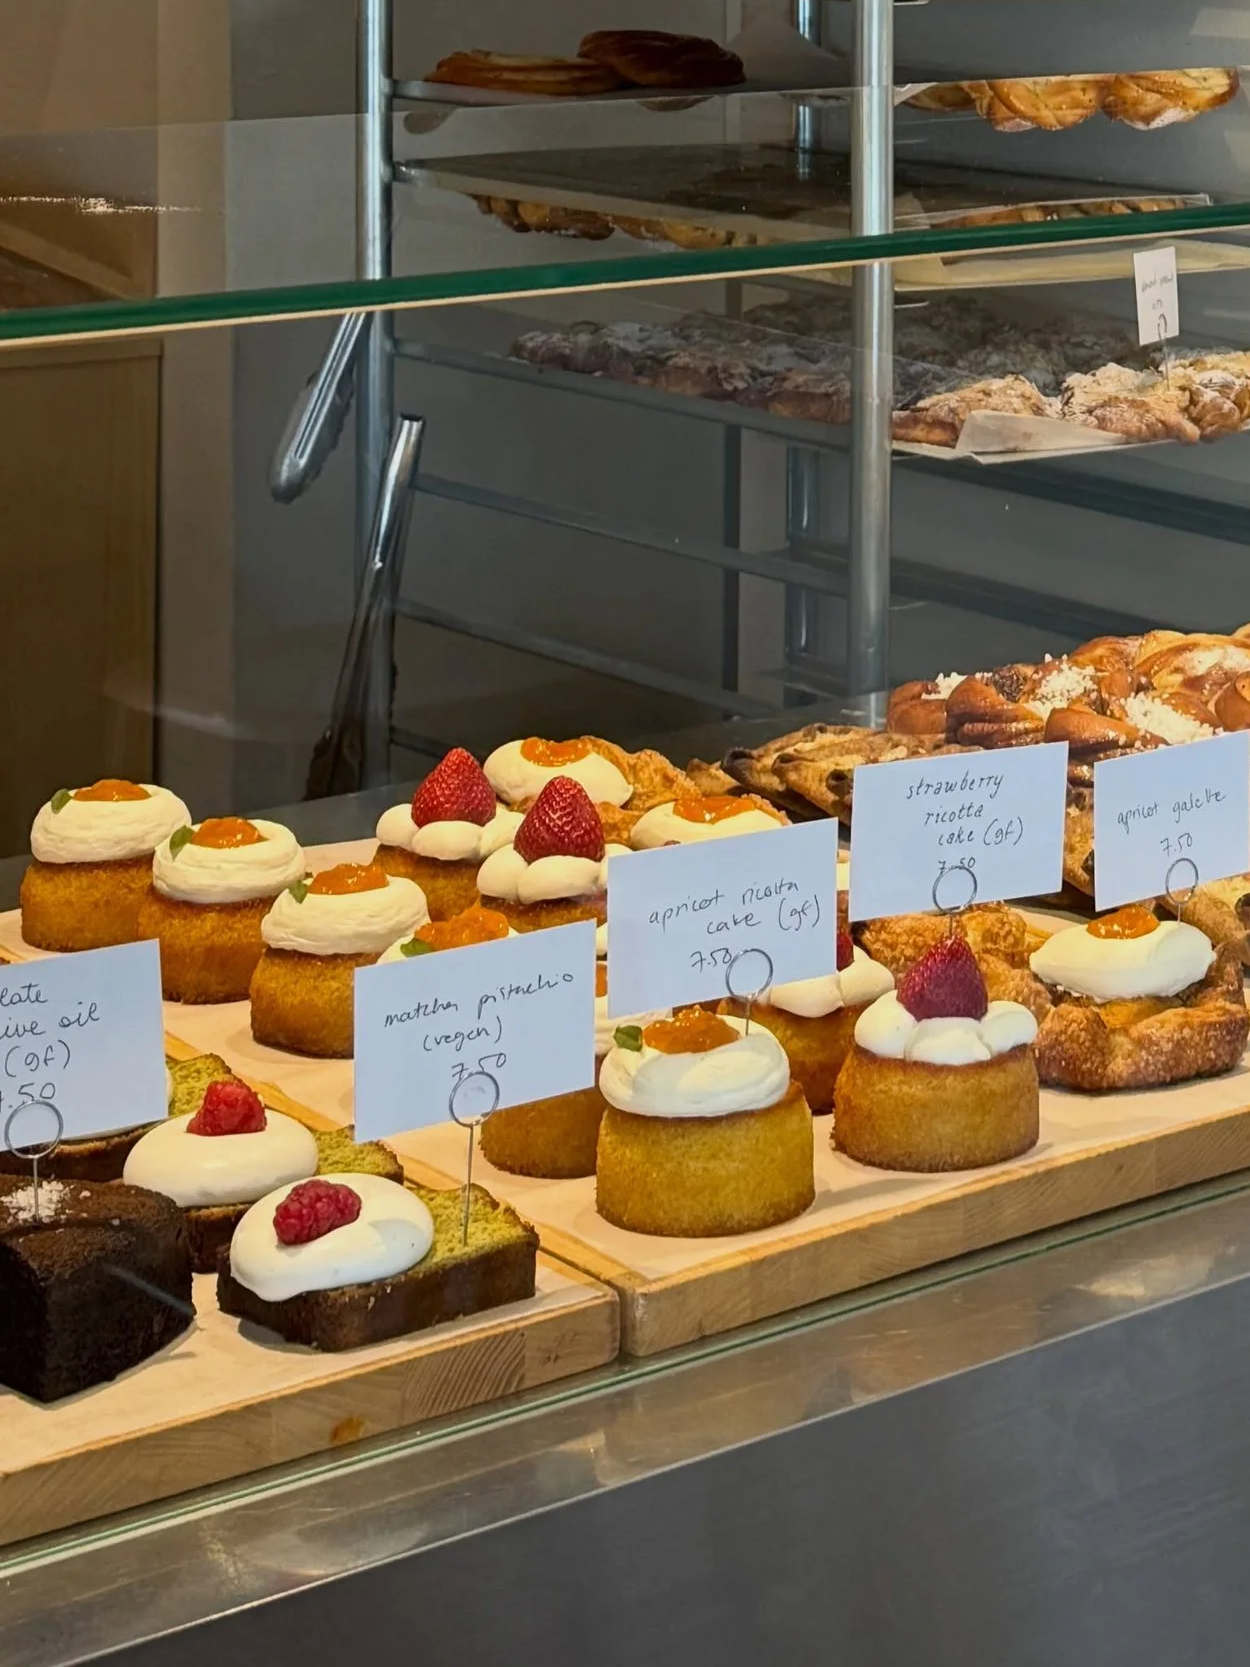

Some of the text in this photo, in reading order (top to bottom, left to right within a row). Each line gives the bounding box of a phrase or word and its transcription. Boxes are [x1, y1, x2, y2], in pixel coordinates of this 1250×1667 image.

[906, 769, 1005, 800] strawberry
[924, 801, 984, 827] ricotta
[1117, 787, 1227, 835] apricot galette
[938, 816, 1024, 846] cake (gf)
[1160, 832, 1193, 857] 7.50
[649, 877, 800, 934] apricot ricotta
[706, 894, 821, 935] cake (gf)
[690, 947, 732, 973] 7.50
[58, 1001, 100, 1028] oil
[5, 1039, 71, 1078] (gf)
[451, 1052, 507, 1080] 7.50
